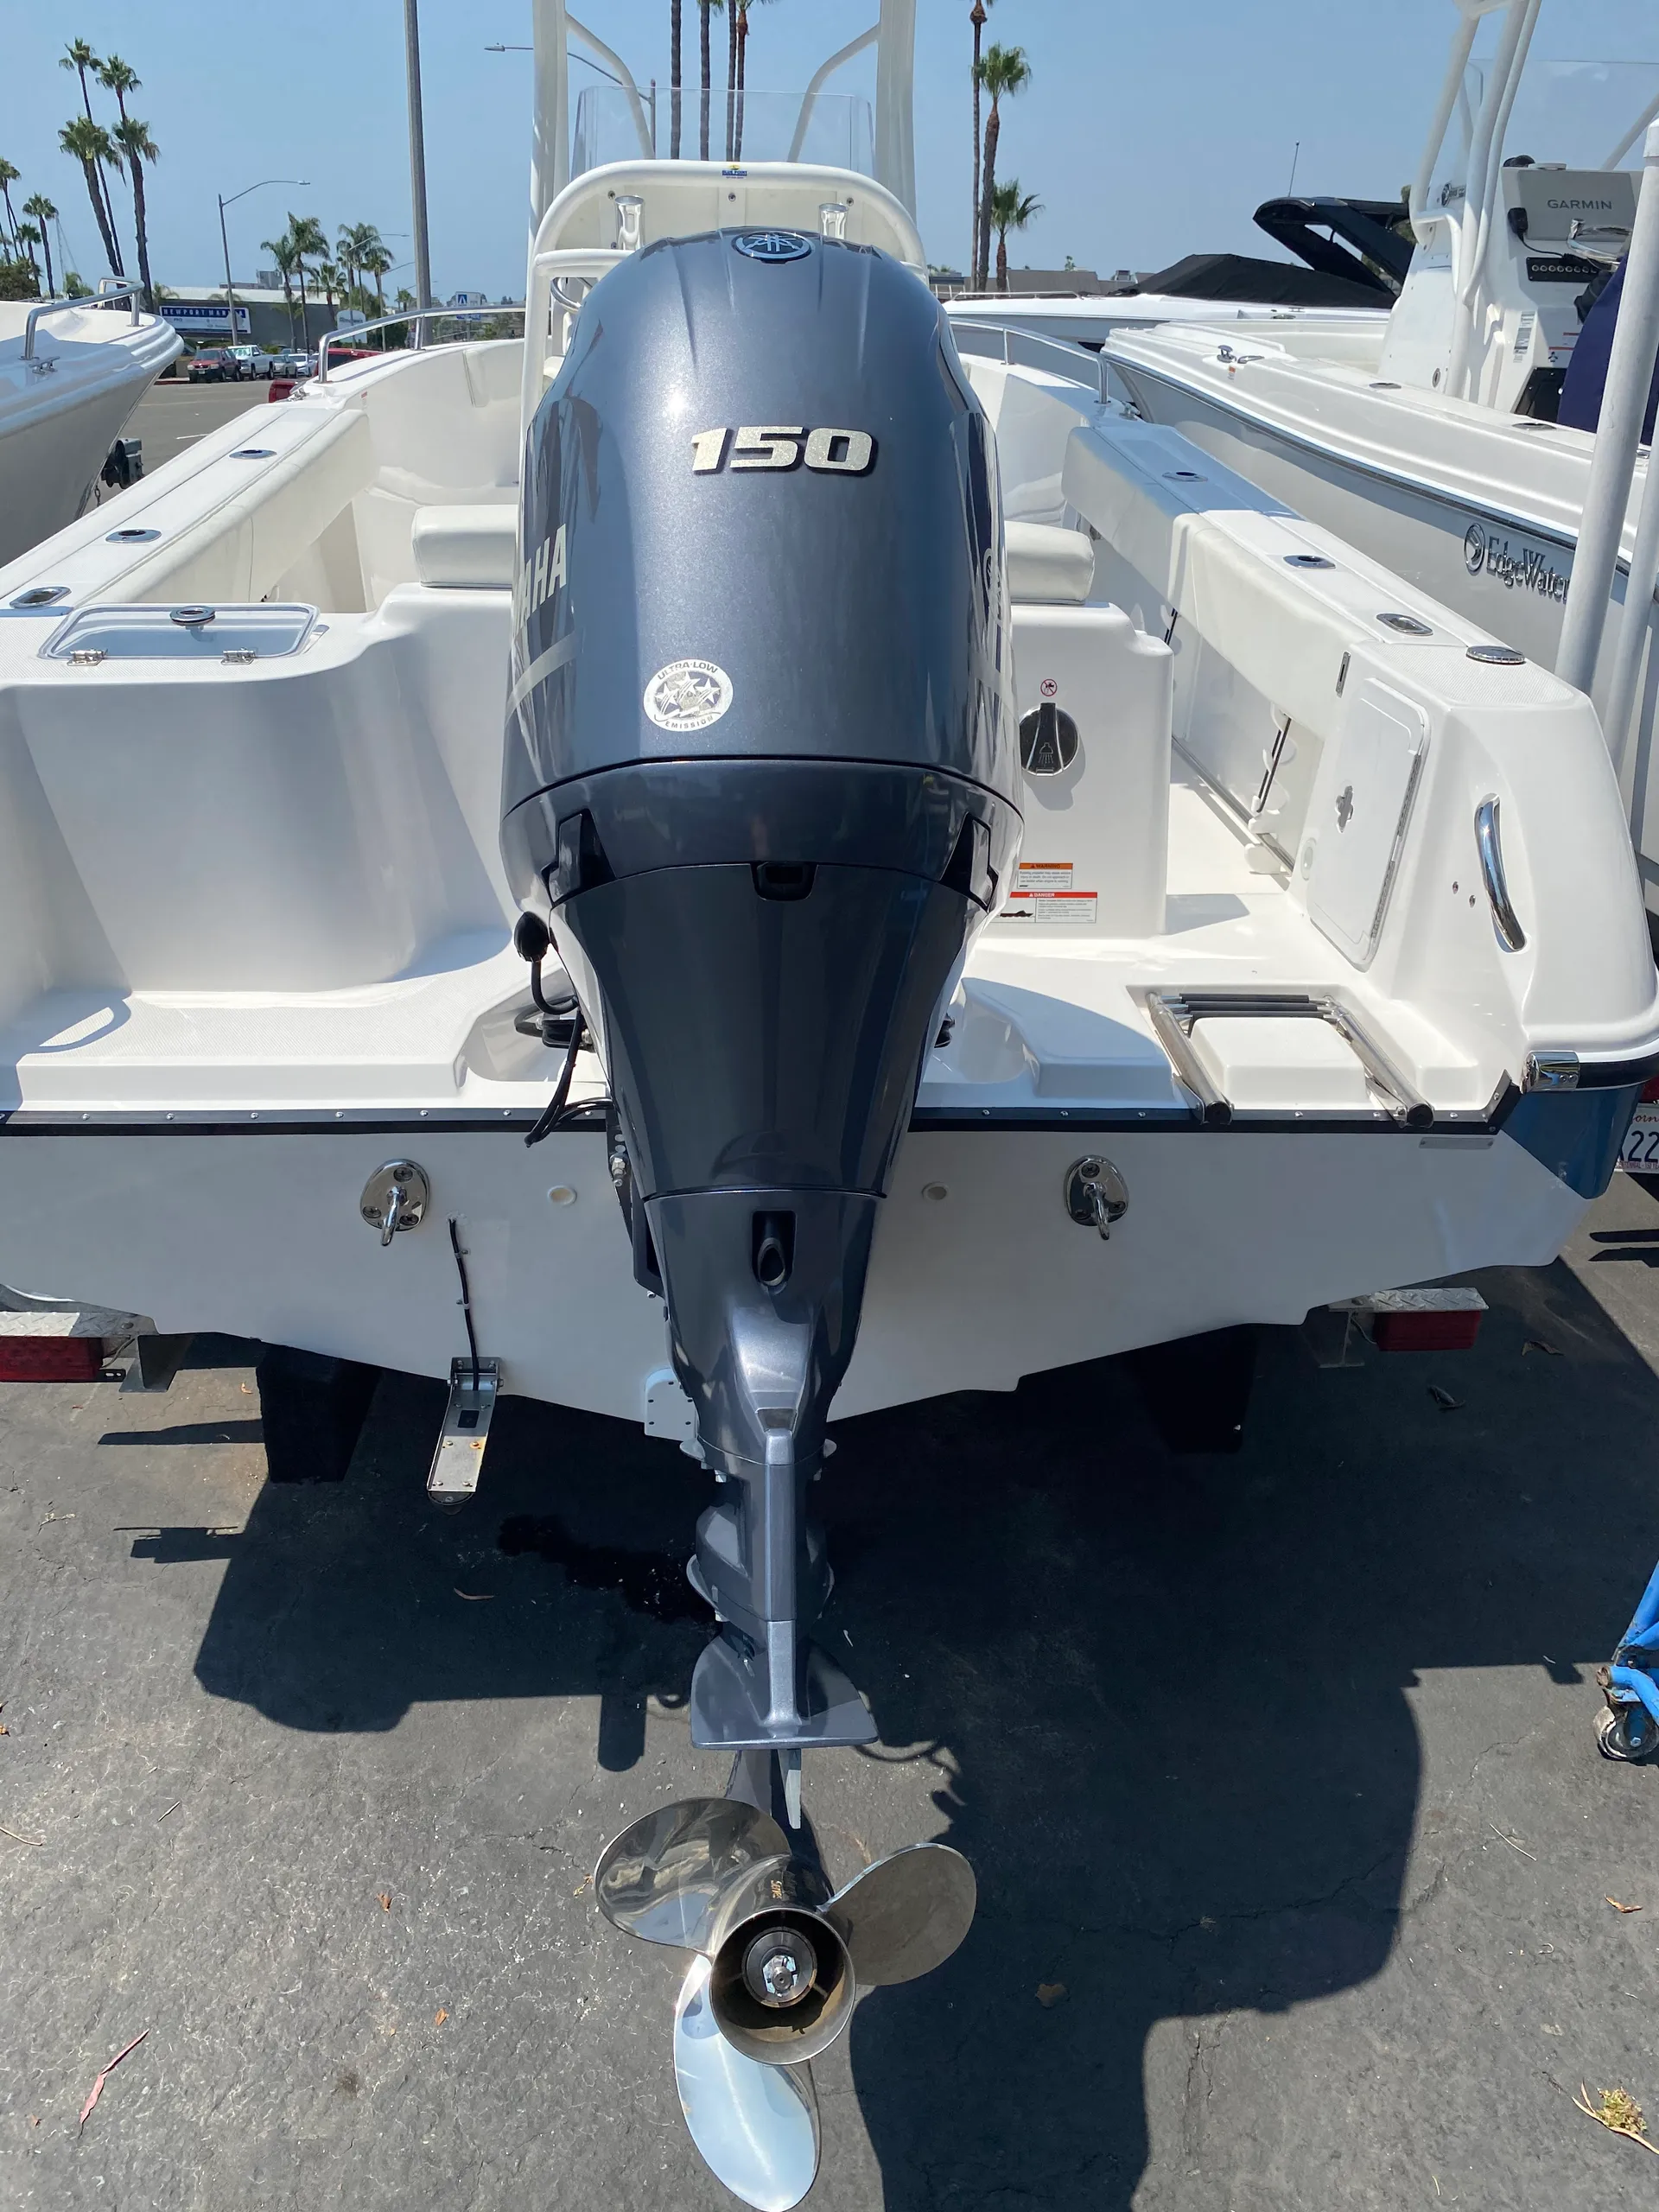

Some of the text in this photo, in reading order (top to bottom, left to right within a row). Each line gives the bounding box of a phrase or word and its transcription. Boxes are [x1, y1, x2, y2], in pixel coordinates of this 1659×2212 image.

[1547, 199, 1612, 210] GARMIN
[691, 426, 876, 474] 150
[518, 523, 567, 632] AHA
[658, 660, 718, 680] ULTRA LOW
[664, 715, 714, 729] EMISSION
